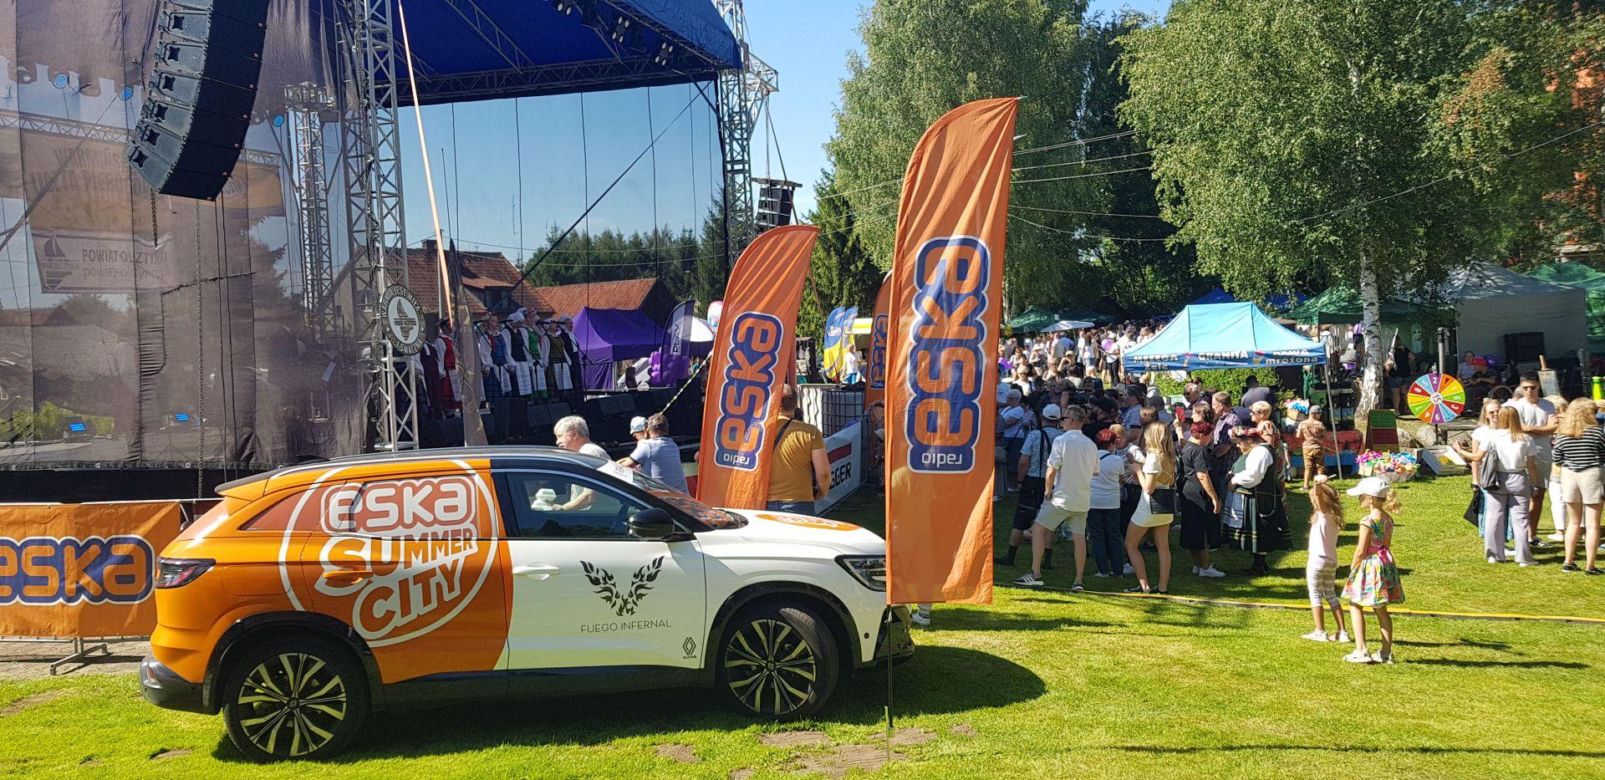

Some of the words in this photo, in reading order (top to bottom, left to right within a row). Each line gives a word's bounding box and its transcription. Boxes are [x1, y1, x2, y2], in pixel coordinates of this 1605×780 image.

[914, 245, 982, 447] eska
[721, 317, 777, 452] eska
[723, 453, 750, 464] radio
[921, 451, 962, 468] radio
[328, 481, 469, 531] eska
[324, 527, 474, 588] SUMMER
[358, 556, 463, 636] CITY
[580, 623, 618, 634] FUEGO
[620, 619, 672, 631] INFERNAL
